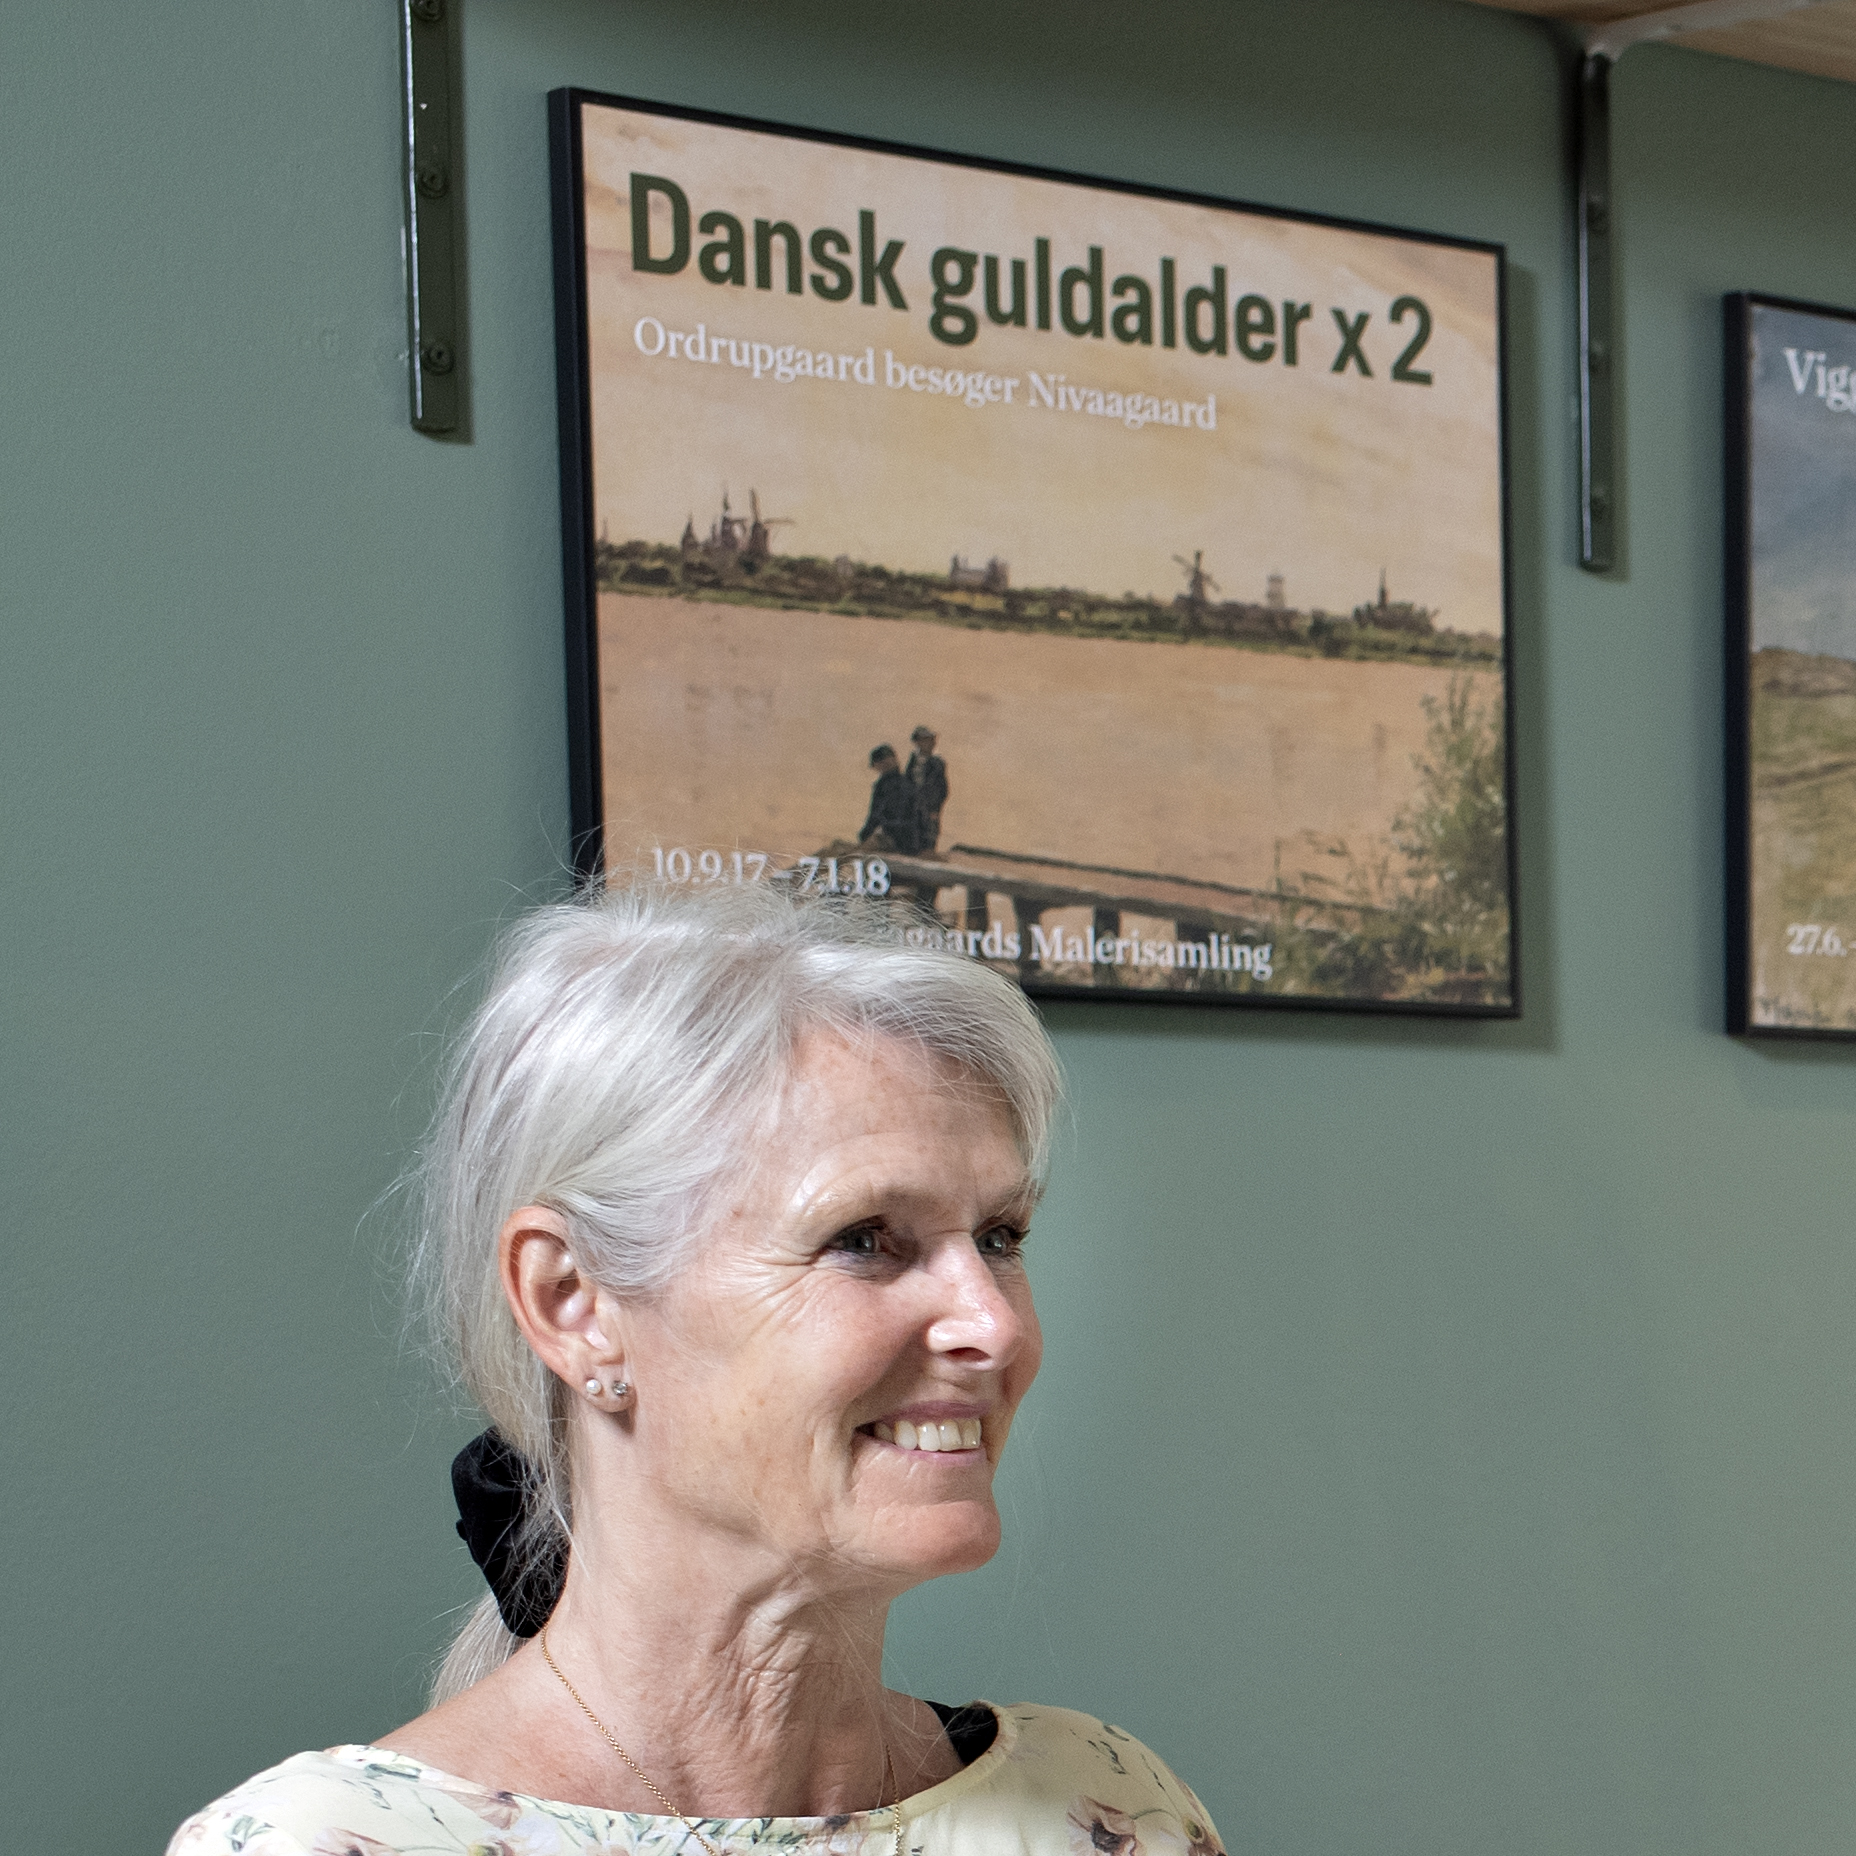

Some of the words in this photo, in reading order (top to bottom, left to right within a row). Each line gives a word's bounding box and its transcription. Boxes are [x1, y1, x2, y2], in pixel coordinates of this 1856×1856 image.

[630, 172, 908, 311] Dansk
[929, 236, 1312, 367] guldalder
[1331, 305, 1373, 378] x
[1391, 296, 1433, 385] 2
[634, 316, 876, 384] Ordrupgaard
[885, 350, 1020, 408] besøger
[1028, 371, 1216, 430] Nivaagaard
[905, 921, 1022, 959] gaards
[1029, 924, 1273, 982] Malerisamling
